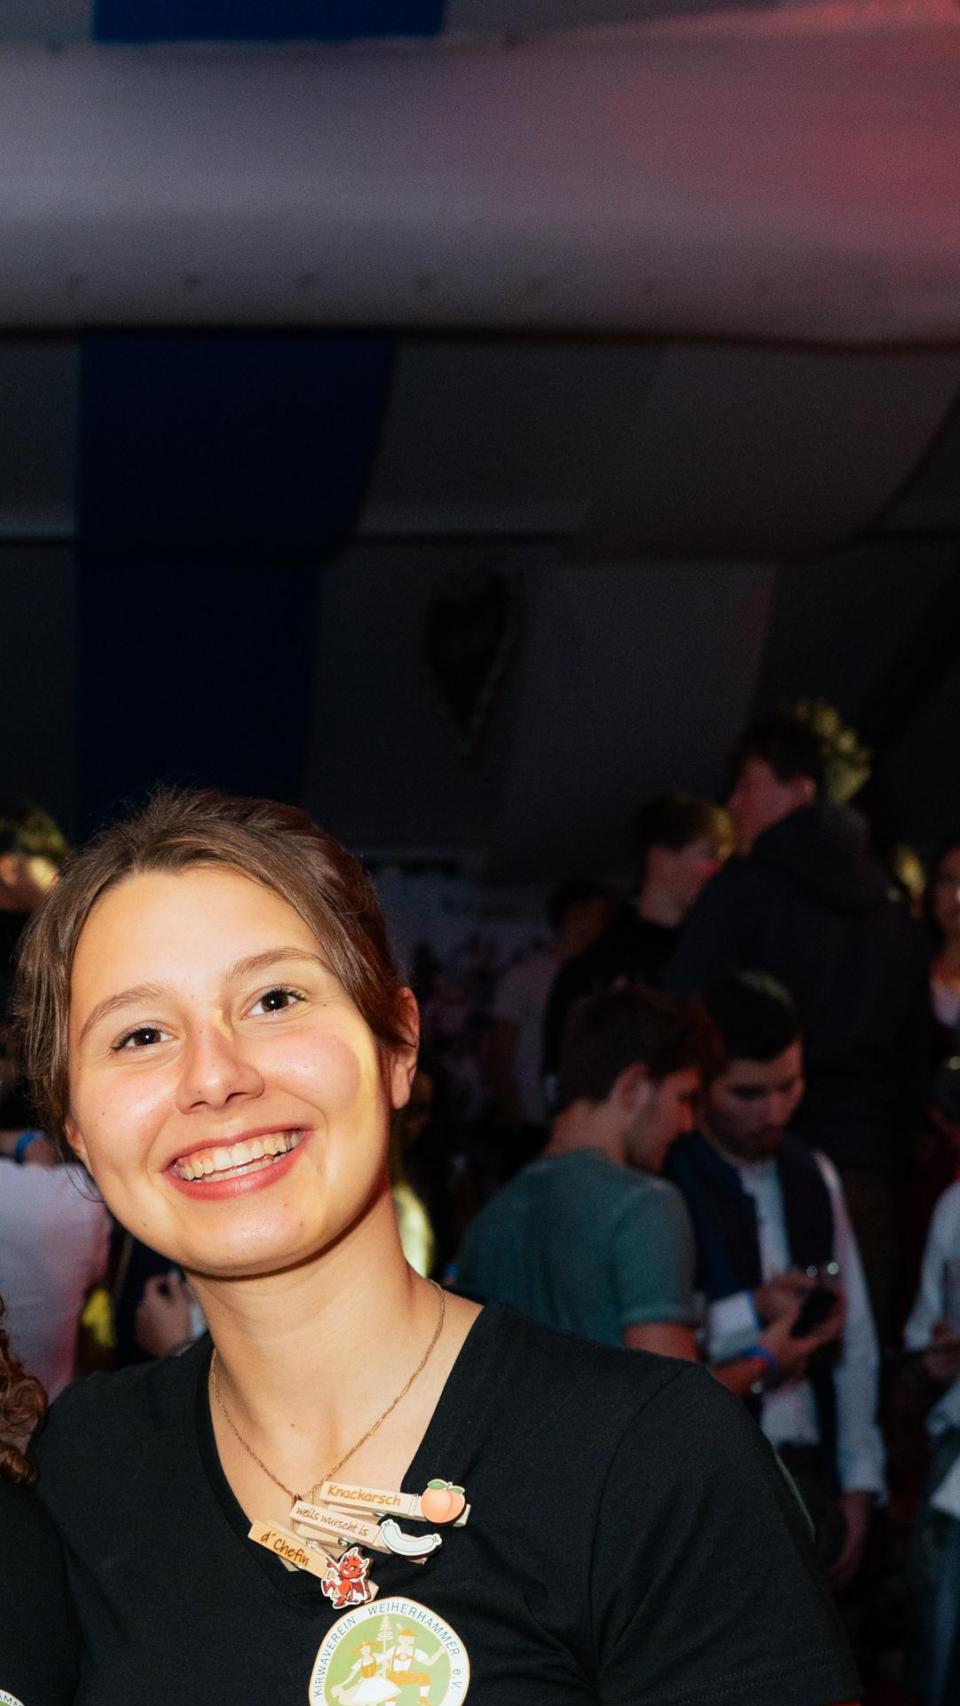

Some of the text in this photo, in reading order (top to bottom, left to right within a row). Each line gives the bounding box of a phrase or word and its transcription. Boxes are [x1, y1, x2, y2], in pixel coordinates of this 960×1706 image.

[327, 1486, 402, 1507] Knackarsch
[273, 1538, 310, 1567] Chefin
[314, 1616, 356, 1698] KIRWAVEREIN
[368, 1602, 460, 1656] WEIHERHAMMER
